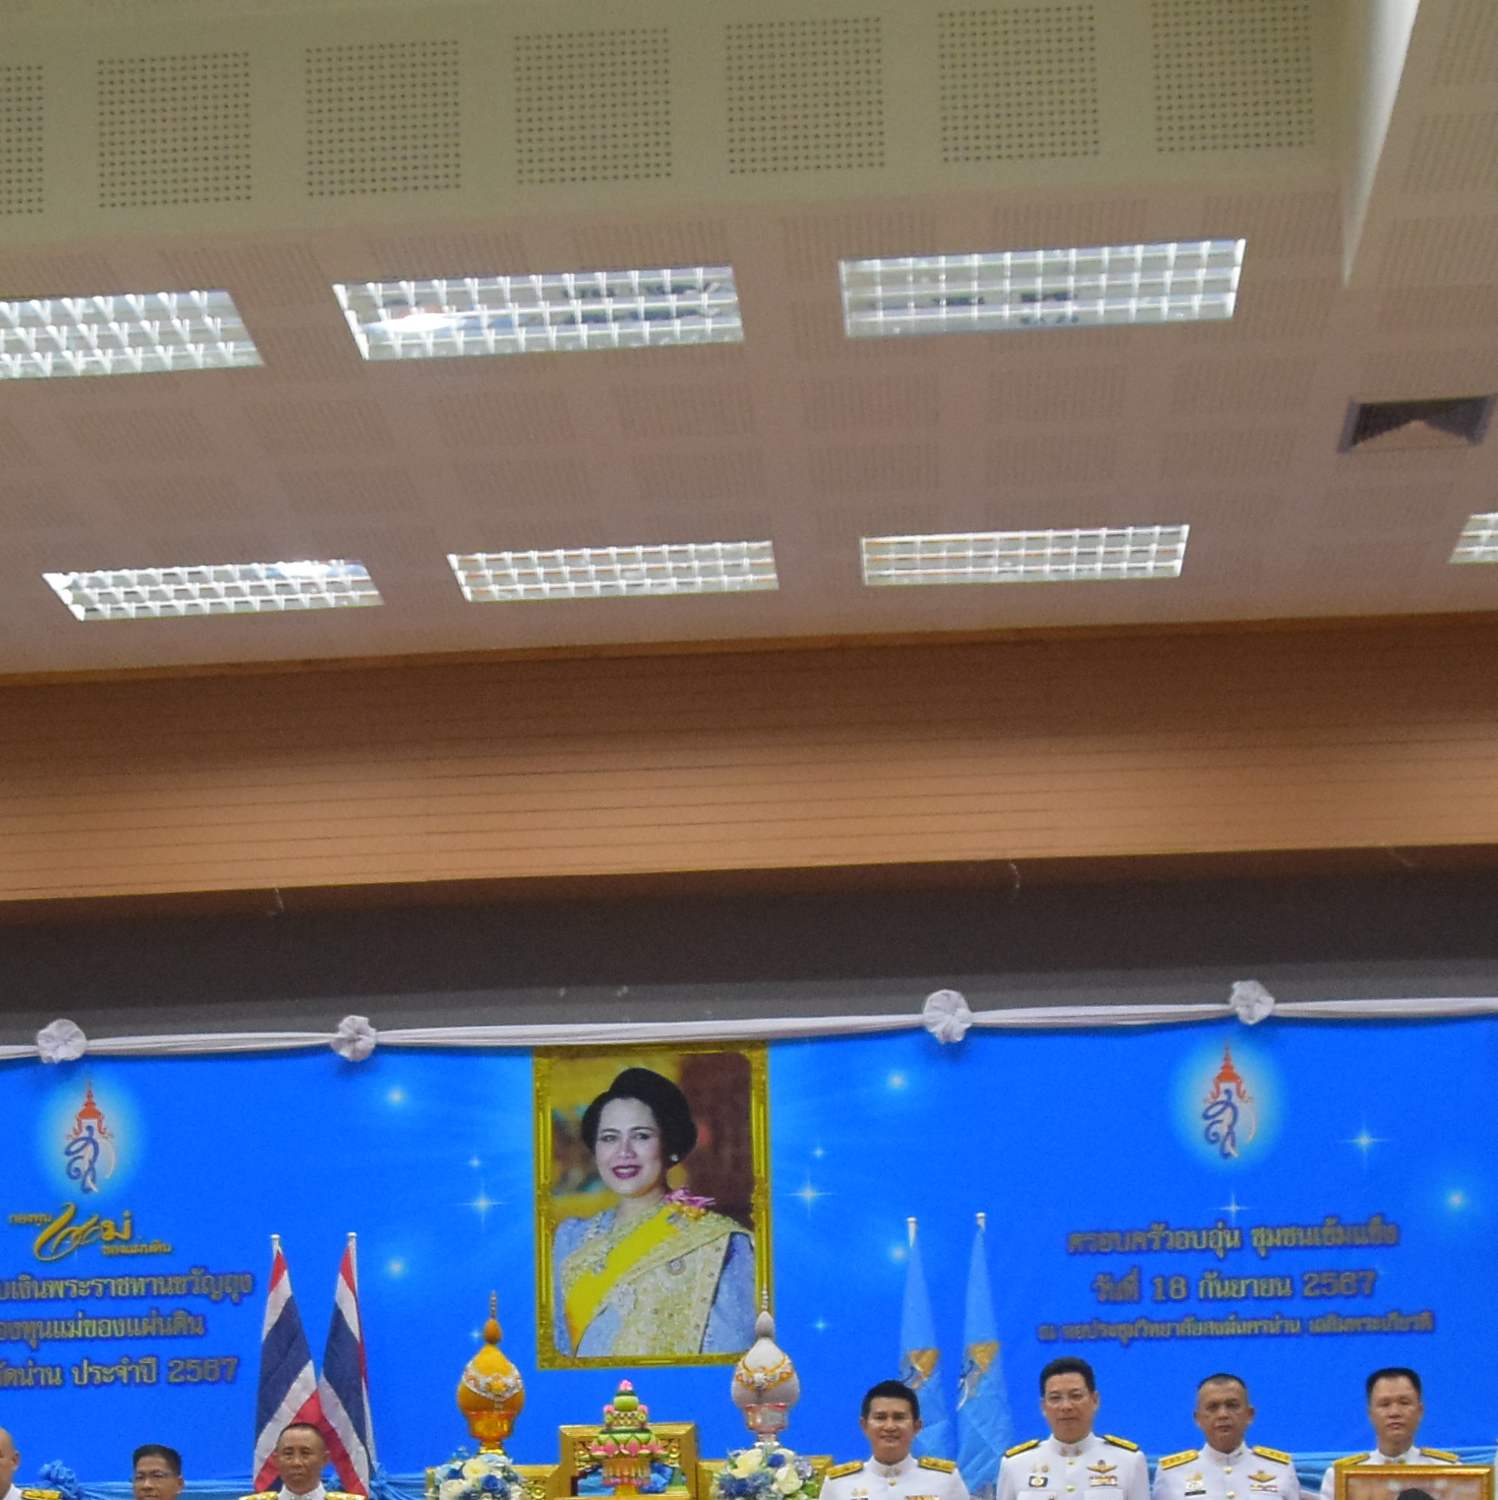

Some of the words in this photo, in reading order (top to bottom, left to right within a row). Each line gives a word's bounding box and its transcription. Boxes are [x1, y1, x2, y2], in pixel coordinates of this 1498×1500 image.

[1153, 1275, 1188, 1302] 18
[1198, 1270, 1294, 1301] กันยายน
[1302, 1270, 1377, 1298] 2567
[71, 1356, 158, 1387] ประจำปี
[167, 1357, 239, 1383] 2567
